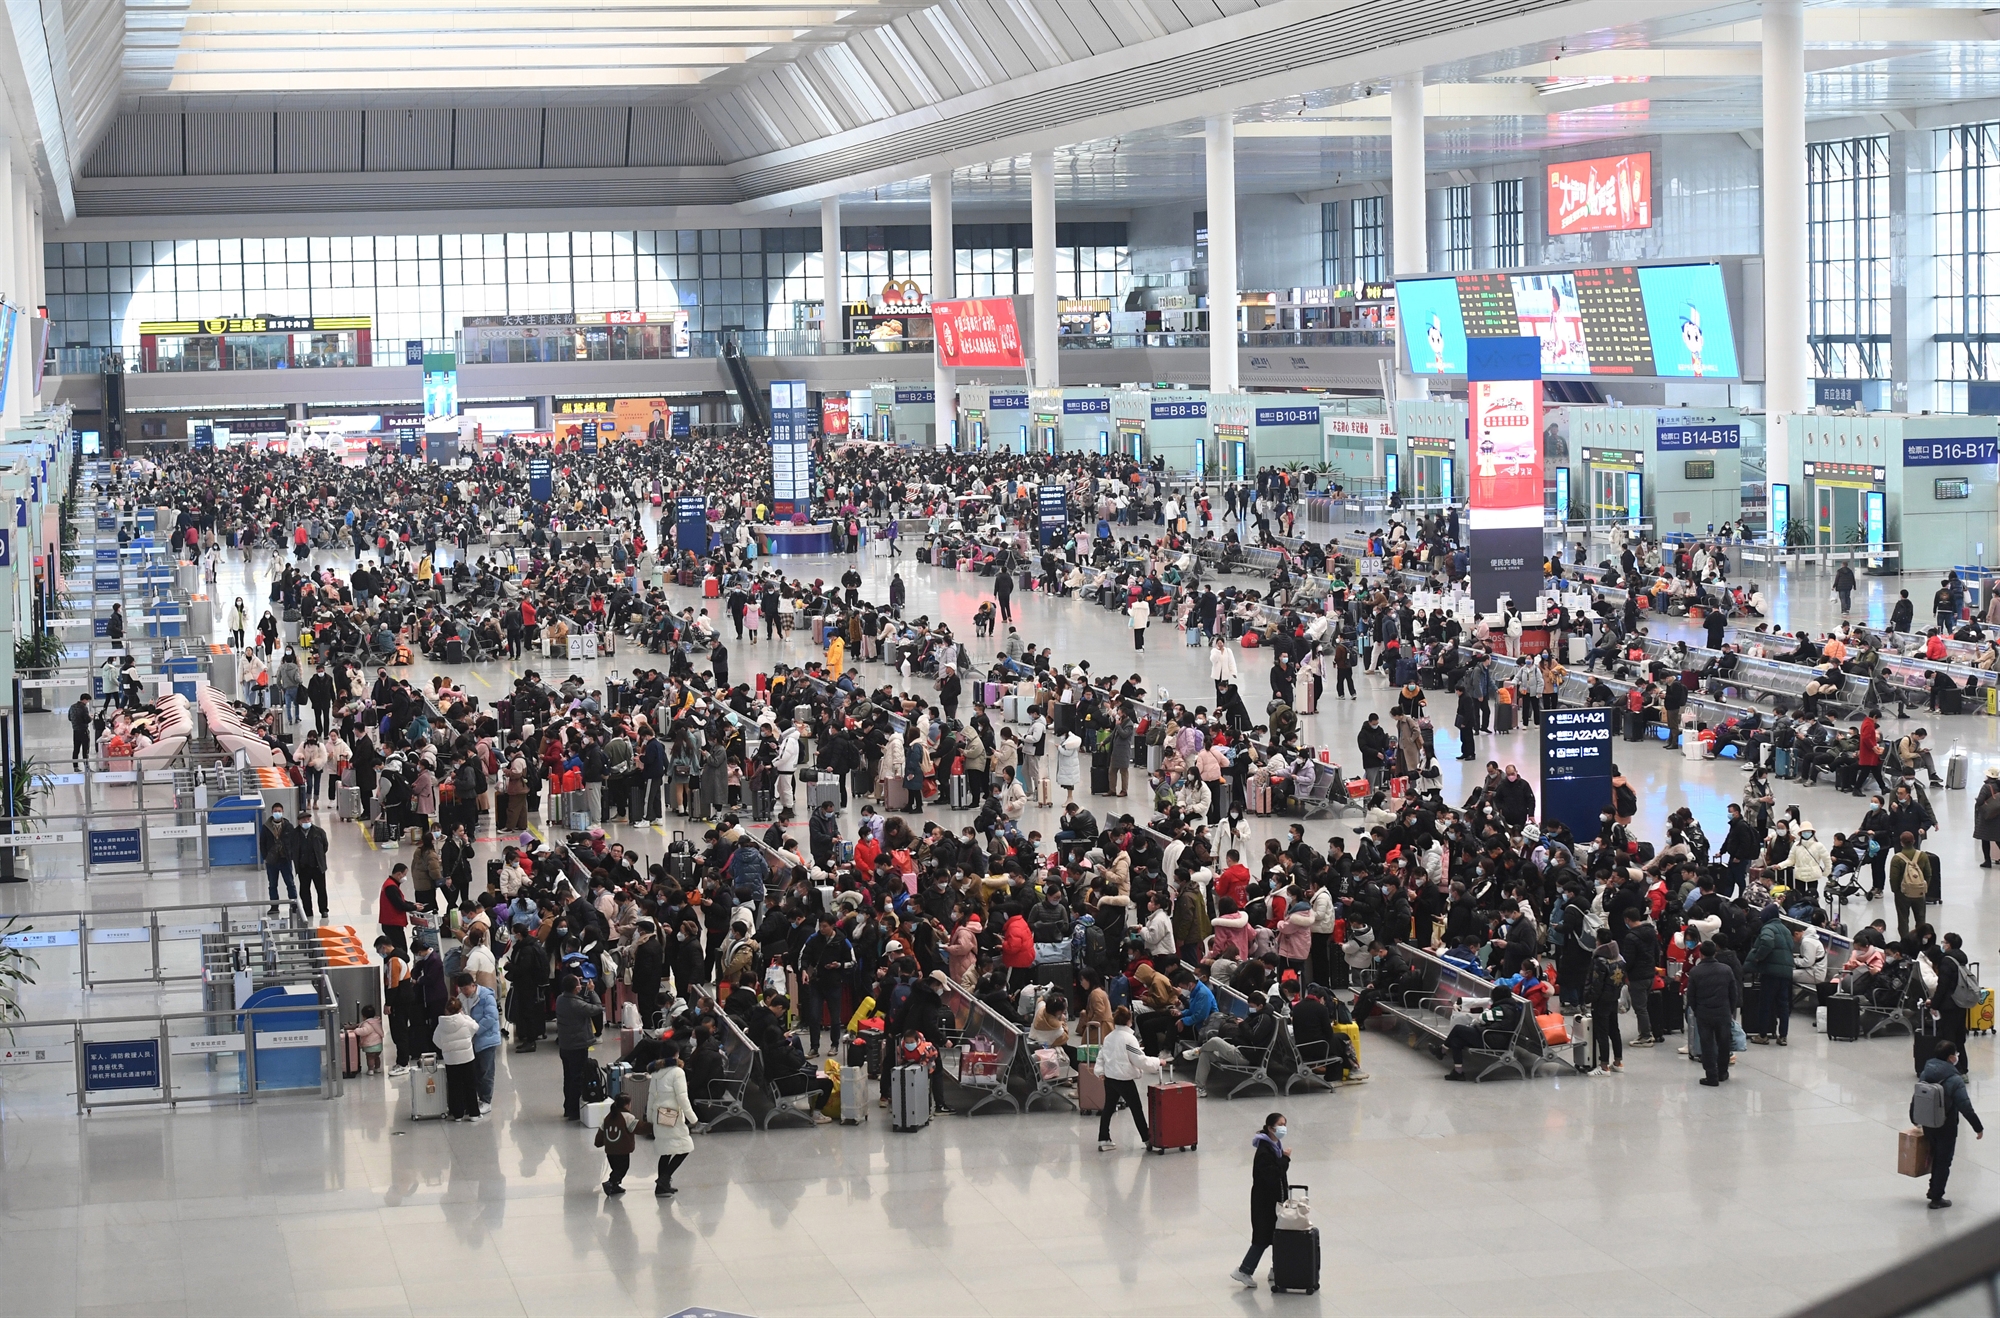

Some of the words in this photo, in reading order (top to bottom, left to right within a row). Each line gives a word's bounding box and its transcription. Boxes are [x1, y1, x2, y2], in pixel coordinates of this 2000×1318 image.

[875, 302, 931, 314] McDonald's
[229, 319, 266, 332] 三品王
[502, 314, 574, 326] 天天生榨米粉
[408, 346, 421, 360] 南
[1824, 388, 1852, 401] 西应急通道
[1170, 405, 1206, 416] B8-B9
[1276, 411, 1317, 422] B10-B11
[1333, 421, 1349, 432] 不忘初心
[1352, 421, 1368, 434] 牢记使命
[1682, 430, 1738, 444] B14-B15
[1908, 446, 1929, 454] 检票口
[1932, 444, 1995, 459] B16-B17
[1490, 558, 1524, 566] 便民充电桩
[1573, 712, 1604, 723] A1-A21
[1573, 729, 1609, 740] A22-A23
[90, 1052, 154, 1060] 军人、消防救援人员、
